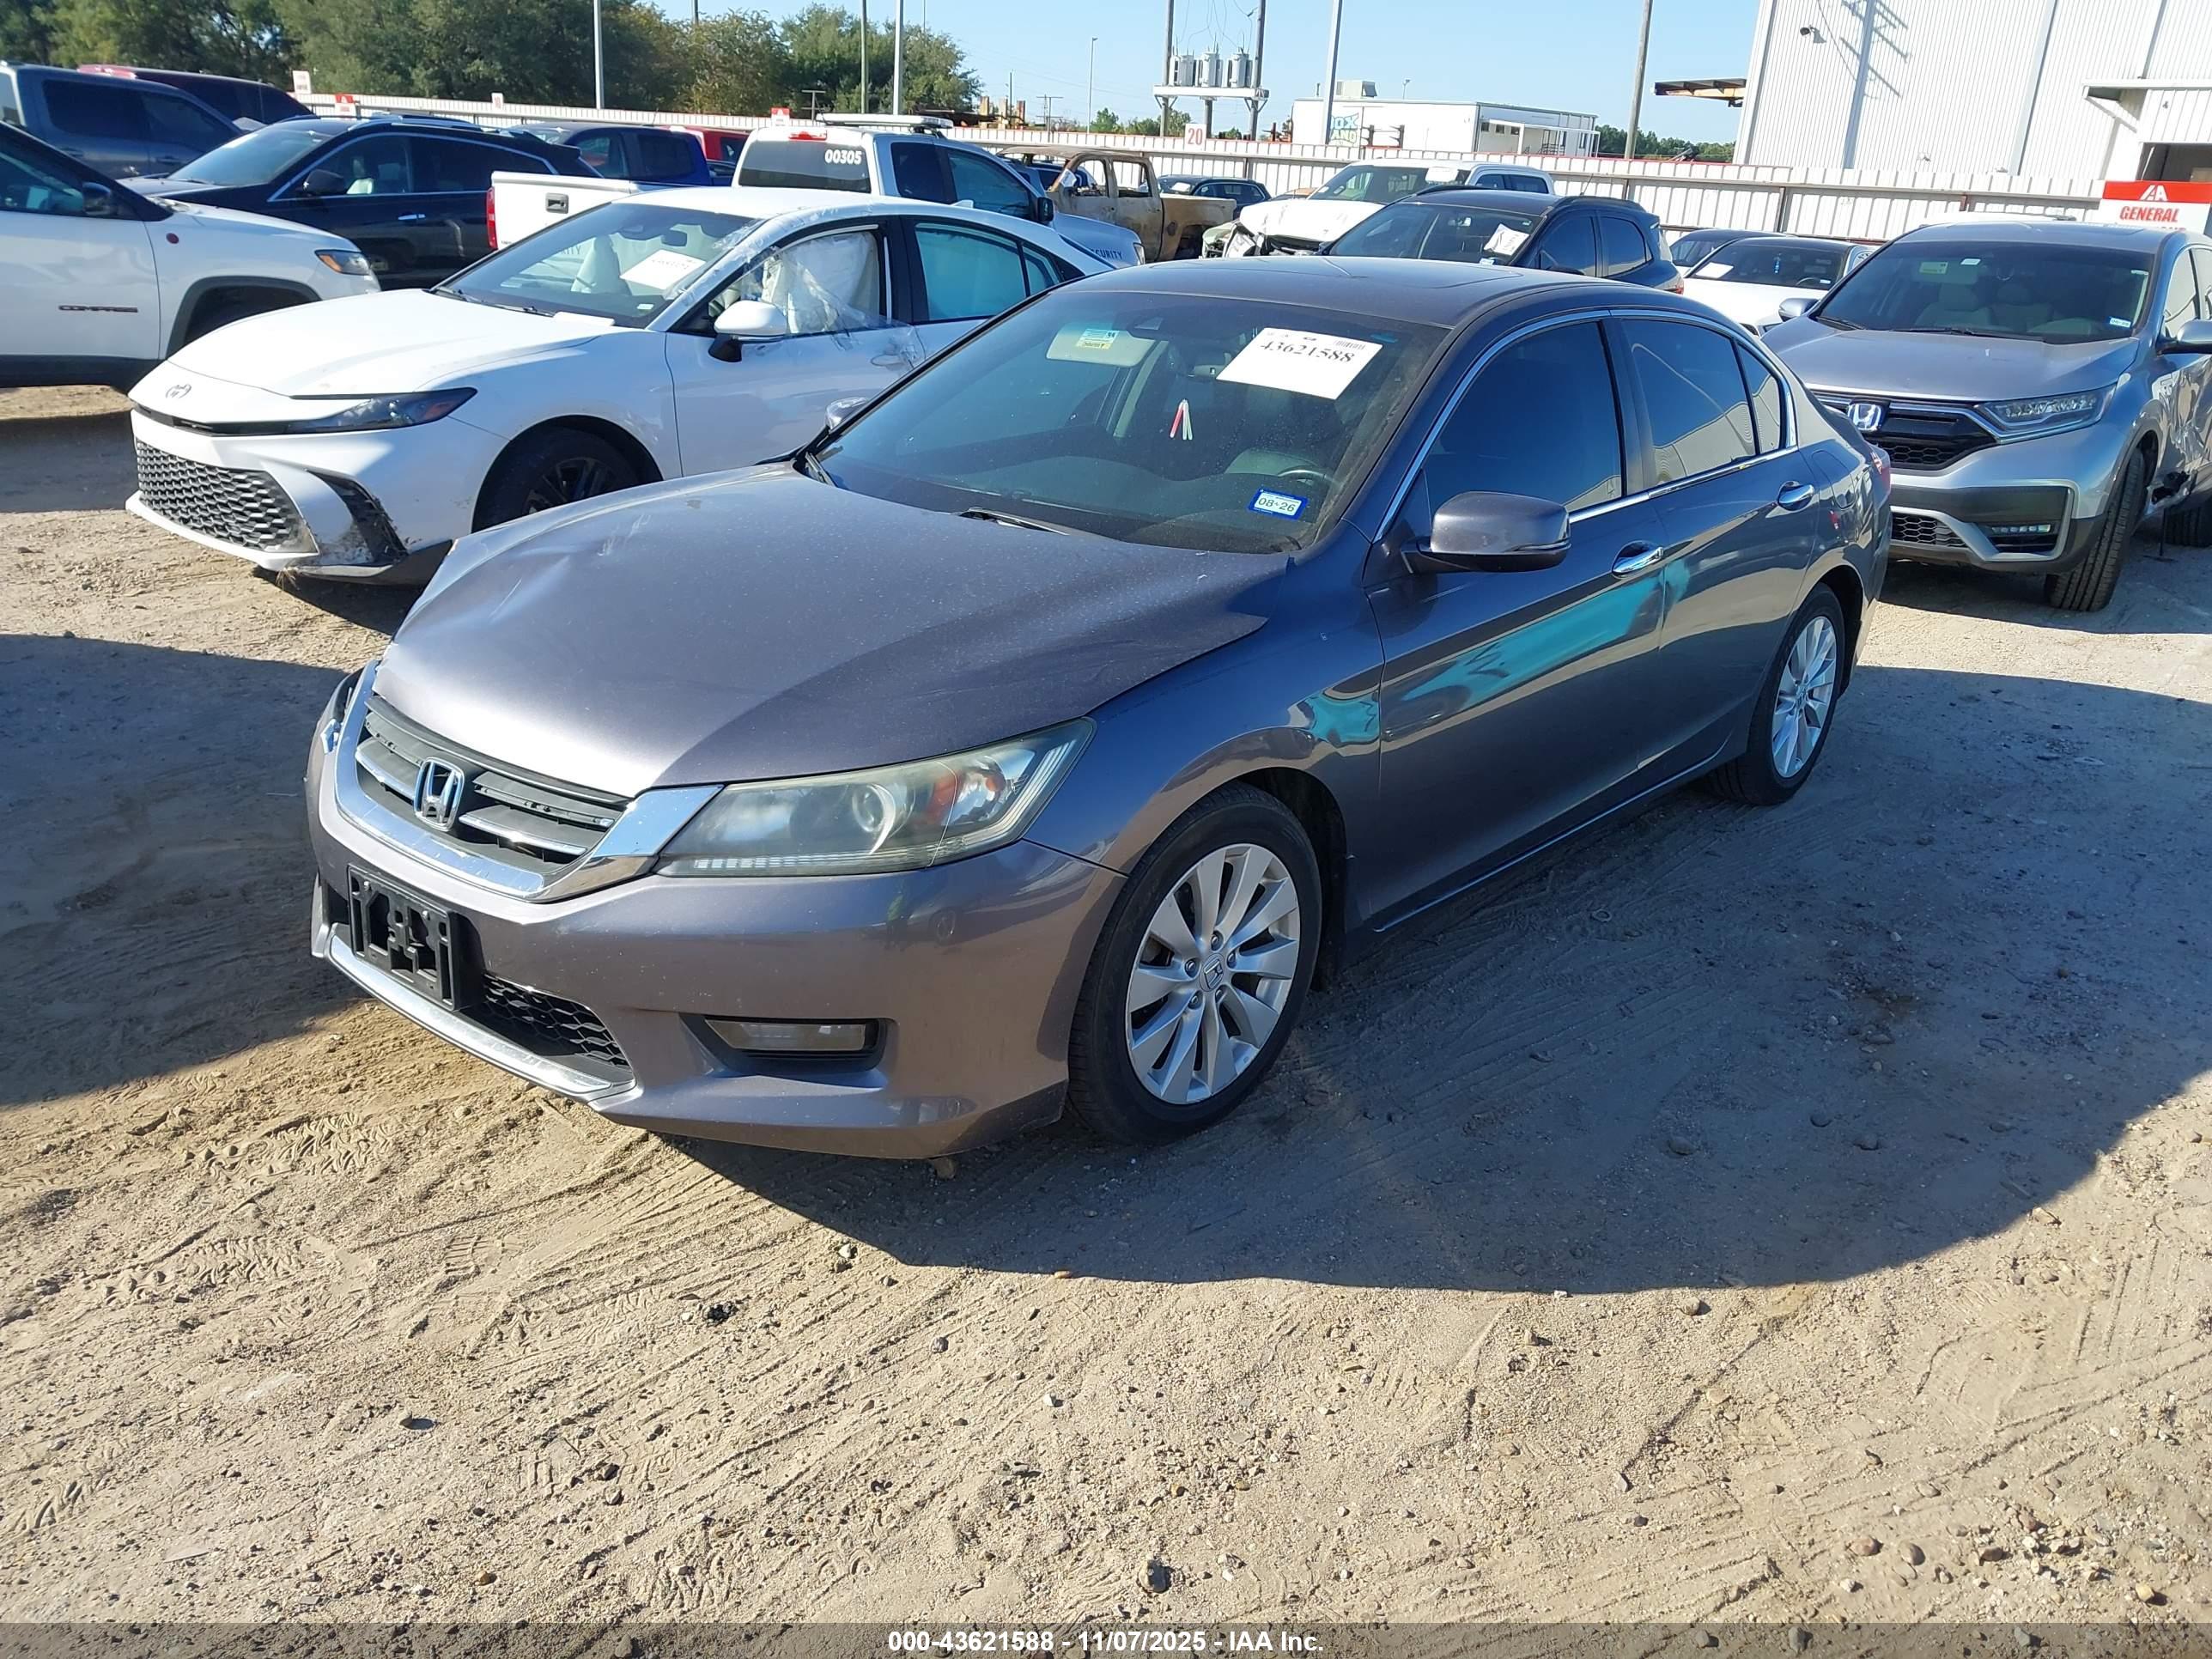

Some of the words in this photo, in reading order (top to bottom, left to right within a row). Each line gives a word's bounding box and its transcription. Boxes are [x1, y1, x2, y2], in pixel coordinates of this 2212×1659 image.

[1188, 128, 1203, 145] 20
[824, 149, 862, 165] 00305
[2119, 205, 2180, 223] GENERAL
[1091, 247, 1122, 260] CURITY
[1261, 341, 1355, 363] 43621588
